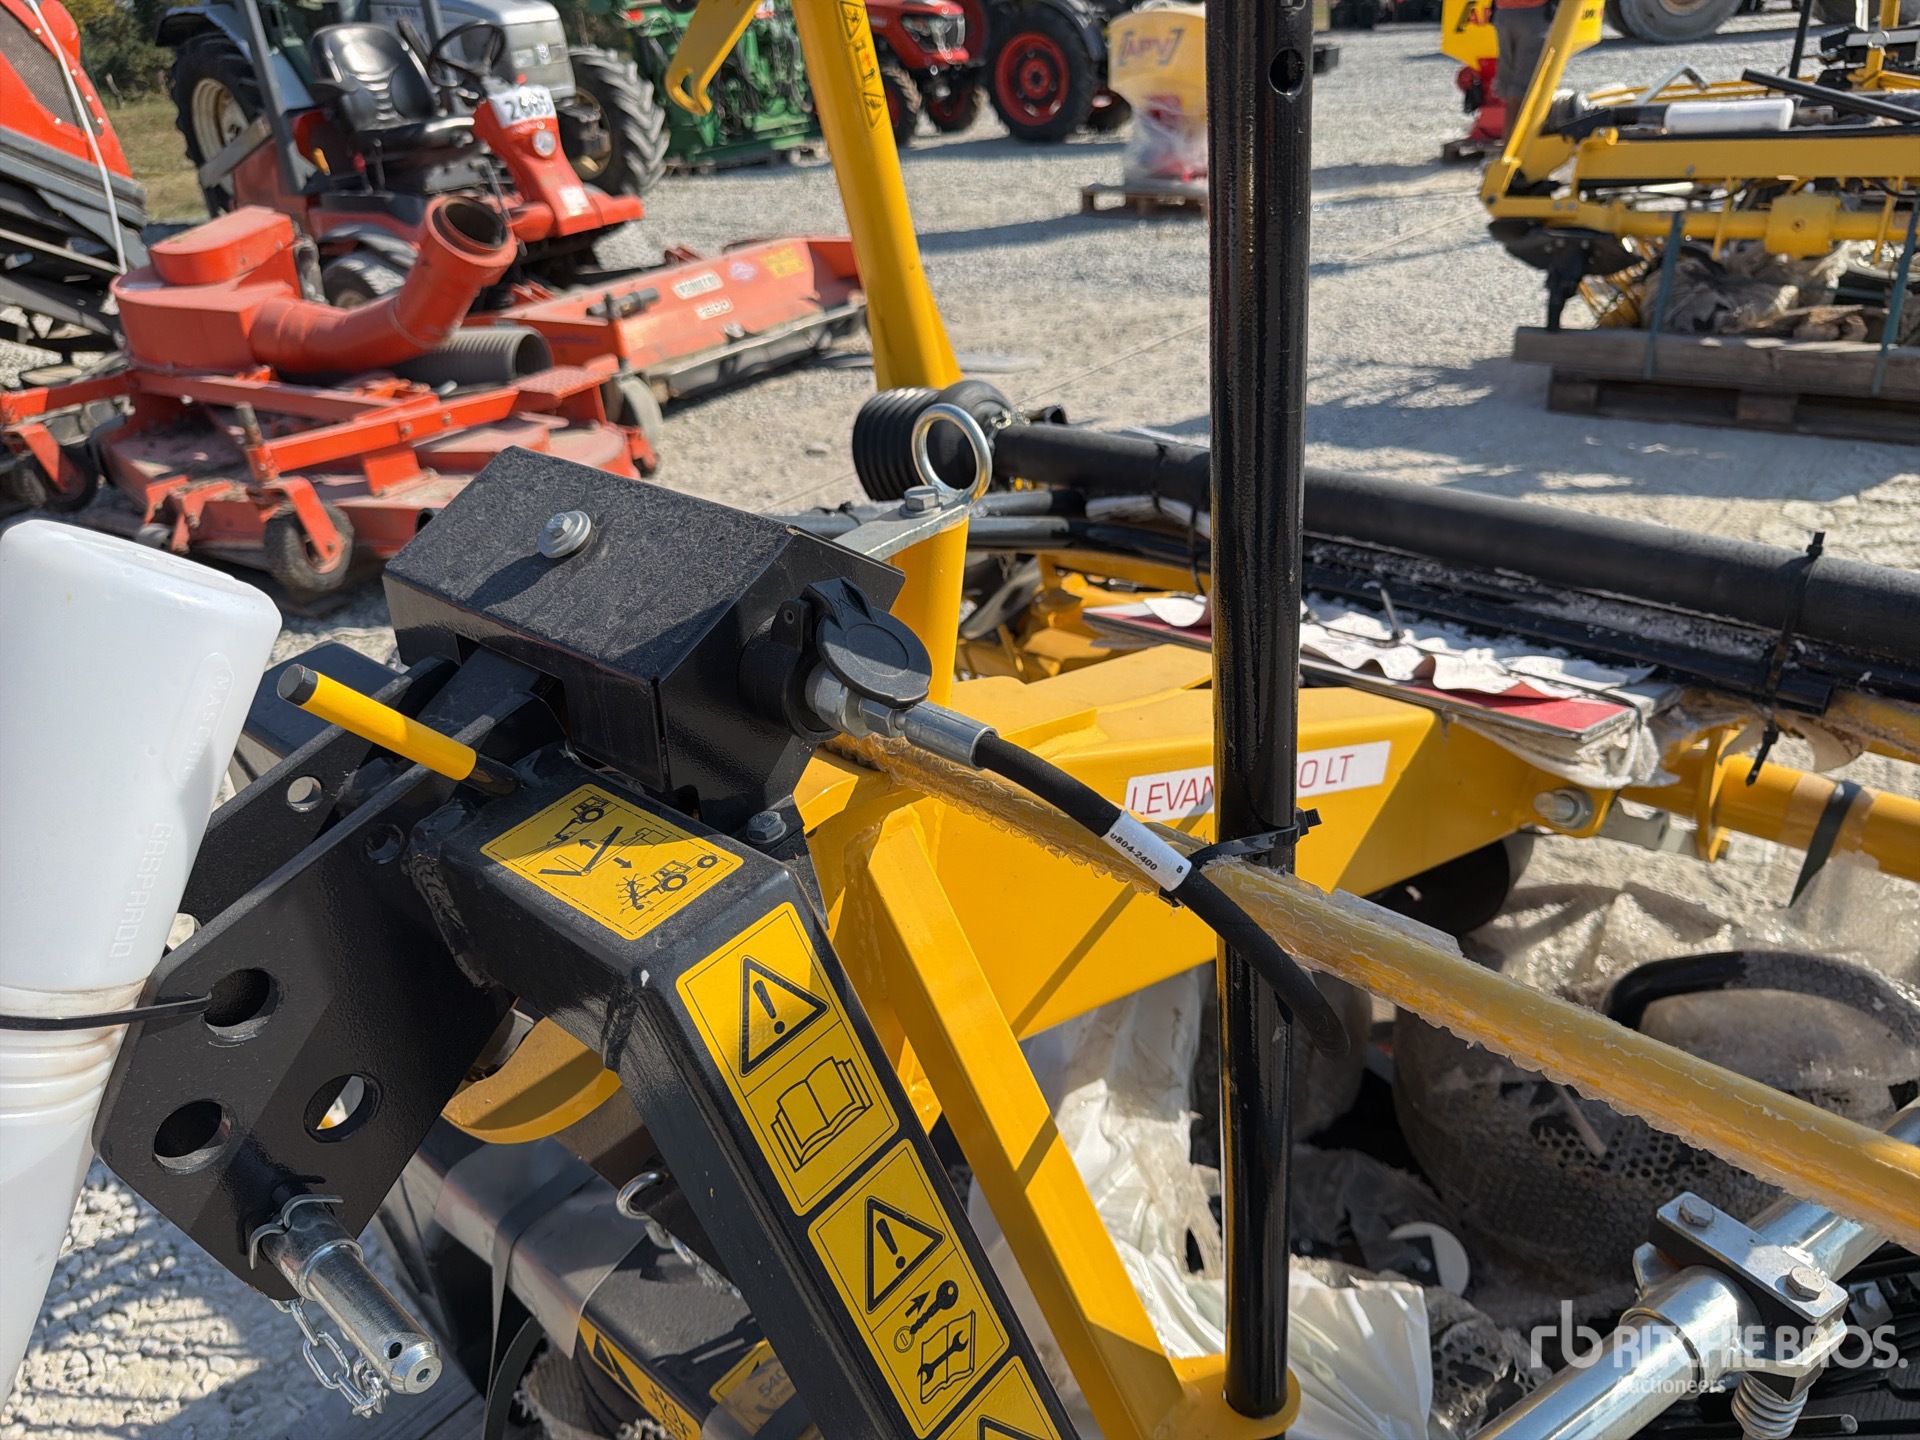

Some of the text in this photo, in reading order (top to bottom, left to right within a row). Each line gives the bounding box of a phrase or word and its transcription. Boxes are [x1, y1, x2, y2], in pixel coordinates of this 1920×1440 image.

[1131, 775, 1214, 815] LEVAN
[1325, 754, 1355, 785] LT
[110, 822, 175, 958] GASPARDO
